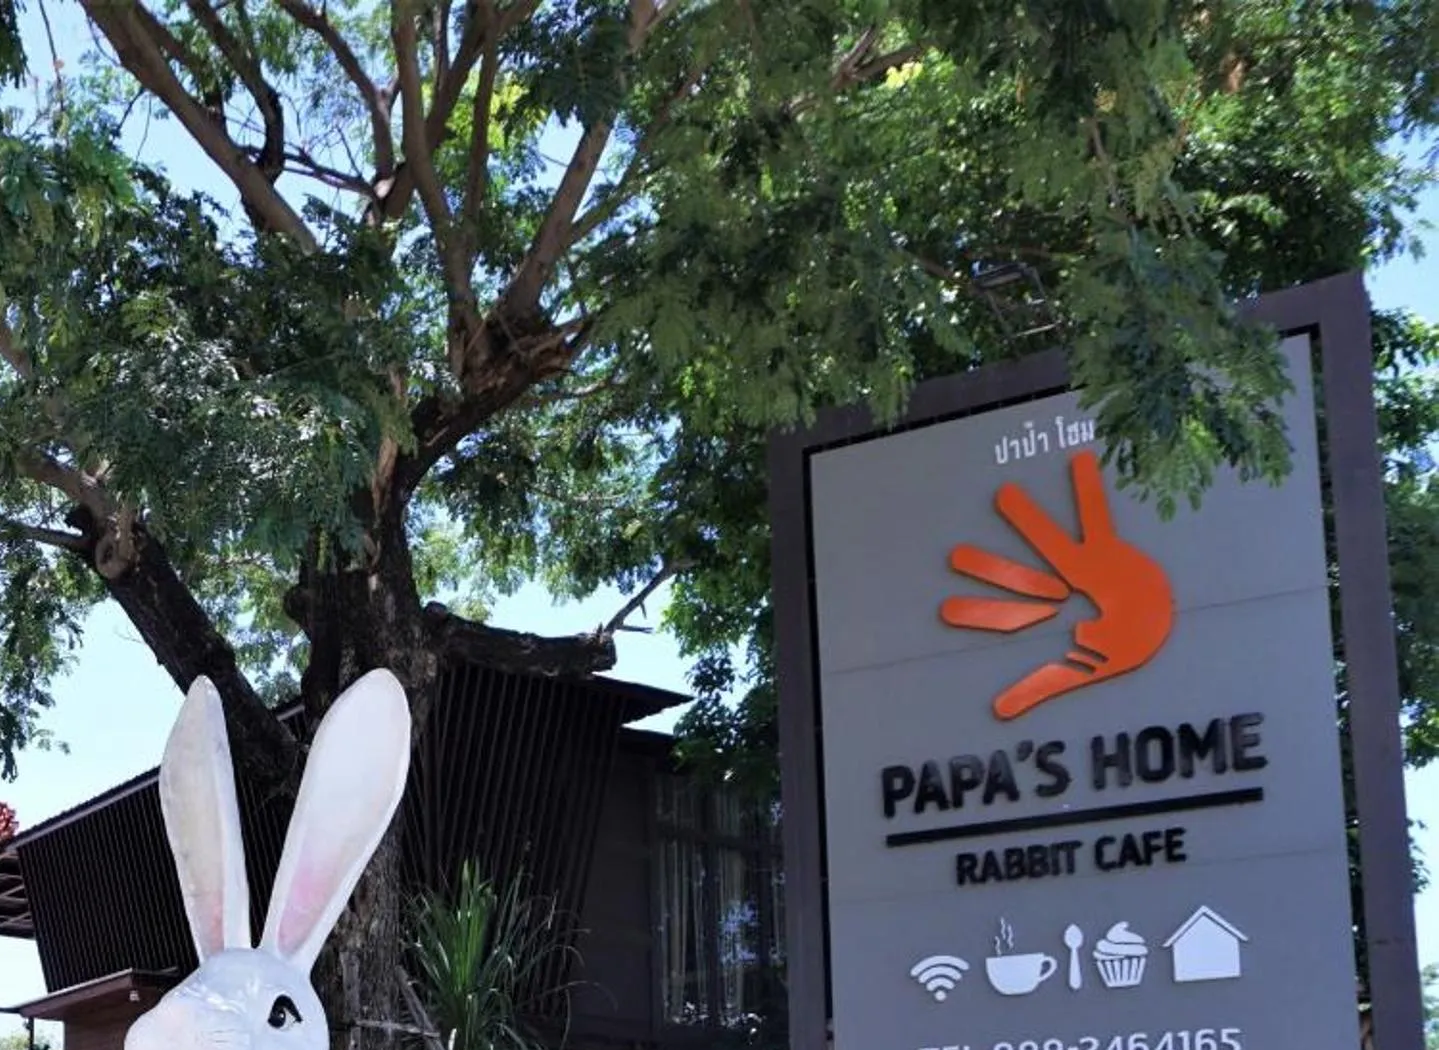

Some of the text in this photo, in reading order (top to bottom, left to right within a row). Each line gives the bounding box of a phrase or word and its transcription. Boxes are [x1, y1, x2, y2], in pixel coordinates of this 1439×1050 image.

[1055, 415, 1095, 449] โฮม
[880, 712, 1269, 819] PAPA'S HOME
[956, 827, 1187, 886] RABBIT CAFE
